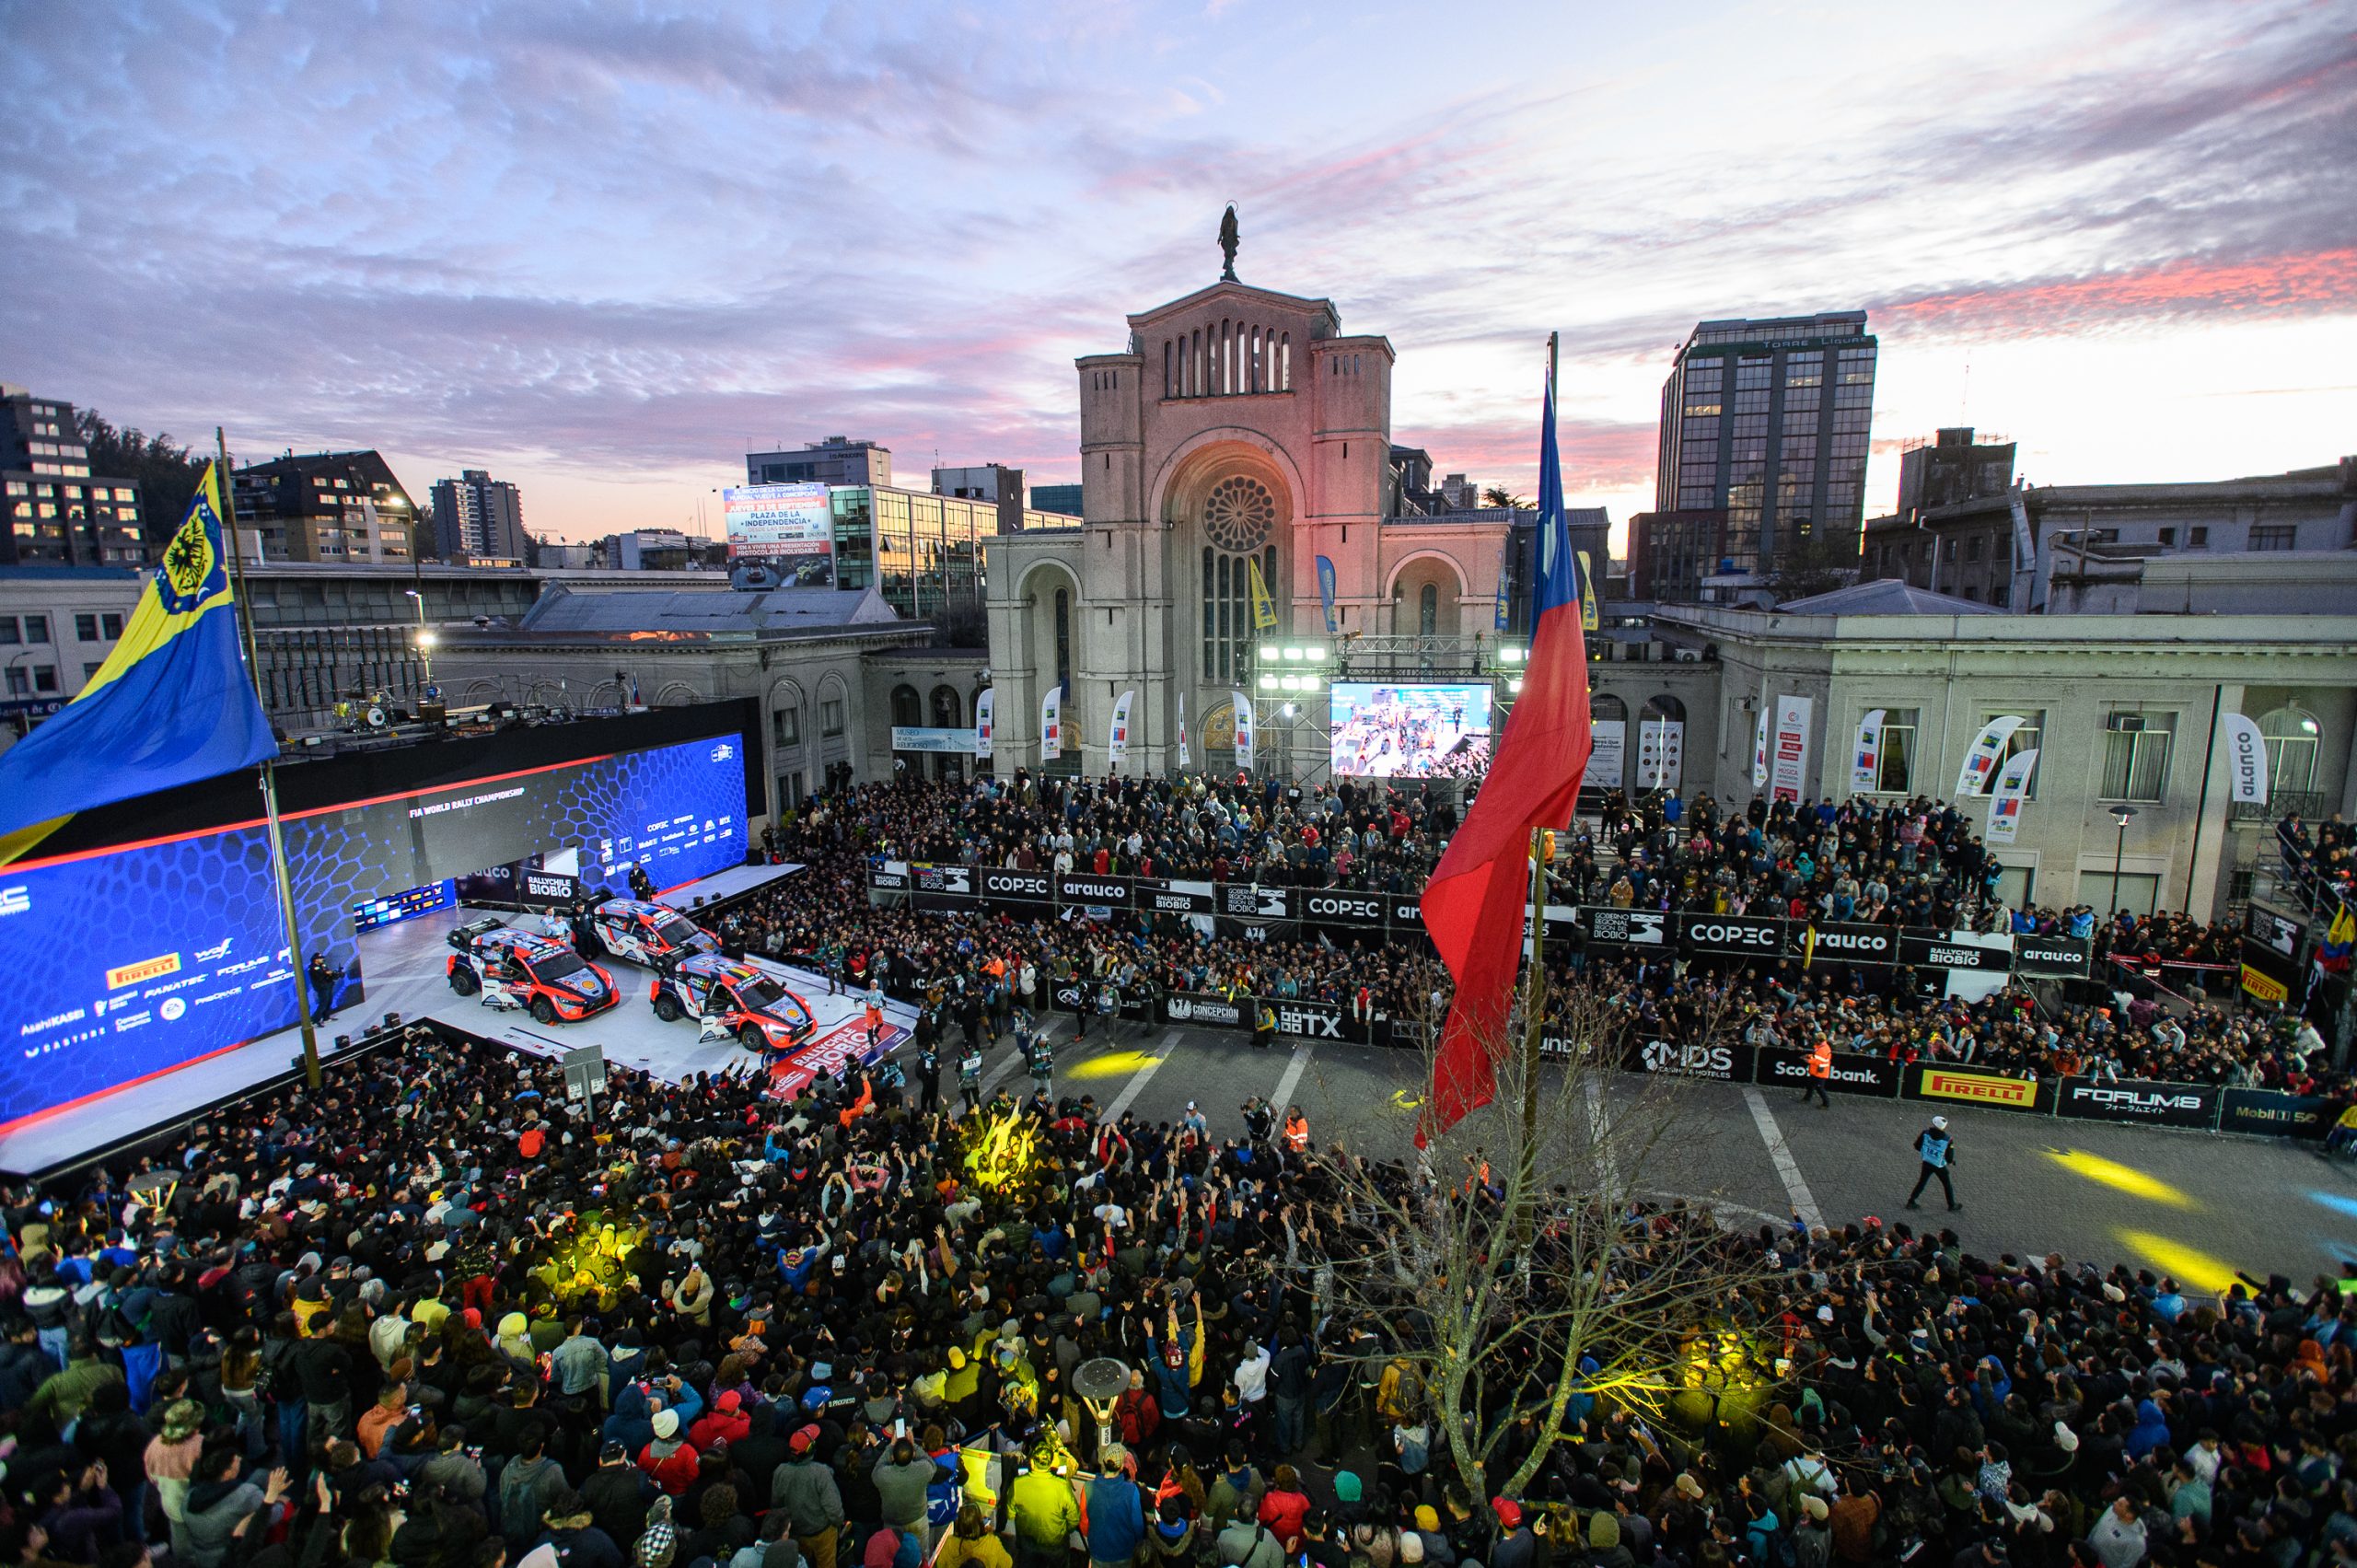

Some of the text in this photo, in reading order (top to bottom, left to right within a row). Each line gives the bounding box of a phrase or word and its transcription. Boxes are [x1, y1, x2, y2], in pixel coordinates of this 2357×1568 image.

[1762, 340, 1809, 349] TORRE
[745, 517, 807, 527] INDEPENDENCIA
[409, 787, 525, 818] FIA WORLD RALLY CHAMPIONSHIP
[647, 820, 669, 832] COPEC
[661, 830, 685, 842] Scotiabank
[528, 876, 571, 887] RALLYCHILE
[988, 876, 1047, 893] COPEC
[1063, 882, 1125, 898] arauco
[1156, 895, 1190, 903] RALLYCHILE
[1309, 898, 1379, 918] COPEC
[1595, 912, 1630, 921] GOBIERNO
[1595, 918, 1629, 926] REGIONAL
[1690, 923, 1775, 946] COPEC
[1930, 947, 1980, 958] RALLYCHILE
[2024, 949, 2083, 963] arauco
[116, 958, 174, 983] PIRELLI
[144, 974, 208, 999] FANATEC
[2242, 970, 2282, 1000] PIRELLI
[115, 1010, 151, 1026] Compact
[1193, 1005, 1238, 1018] CONCEPCIÓN
[1281, 1005, 1341, 1017] GRUPO
[116, 1016, 152, 1032] Dynamics
[42, 1027, 106, 1053] CASTORE
[793, 1027, 857, 1066] RALLYCHILE
[1659, 1042, 1733, 1070] MDS
[1695, 1070, 1731, 1079] HOTELES
[1774, 1061, 1877, 1084] Scobank
[1932, 1075, 2026, 1100] PIRELLI
[2073, 1087, 2201, 1109] FORUM8
[2105, 1103, 2165, 1114] フォーラムエイト
[2235, 1106, 2276, 1120] Mobil
[1104, 1429, 1109, 1444] 58
